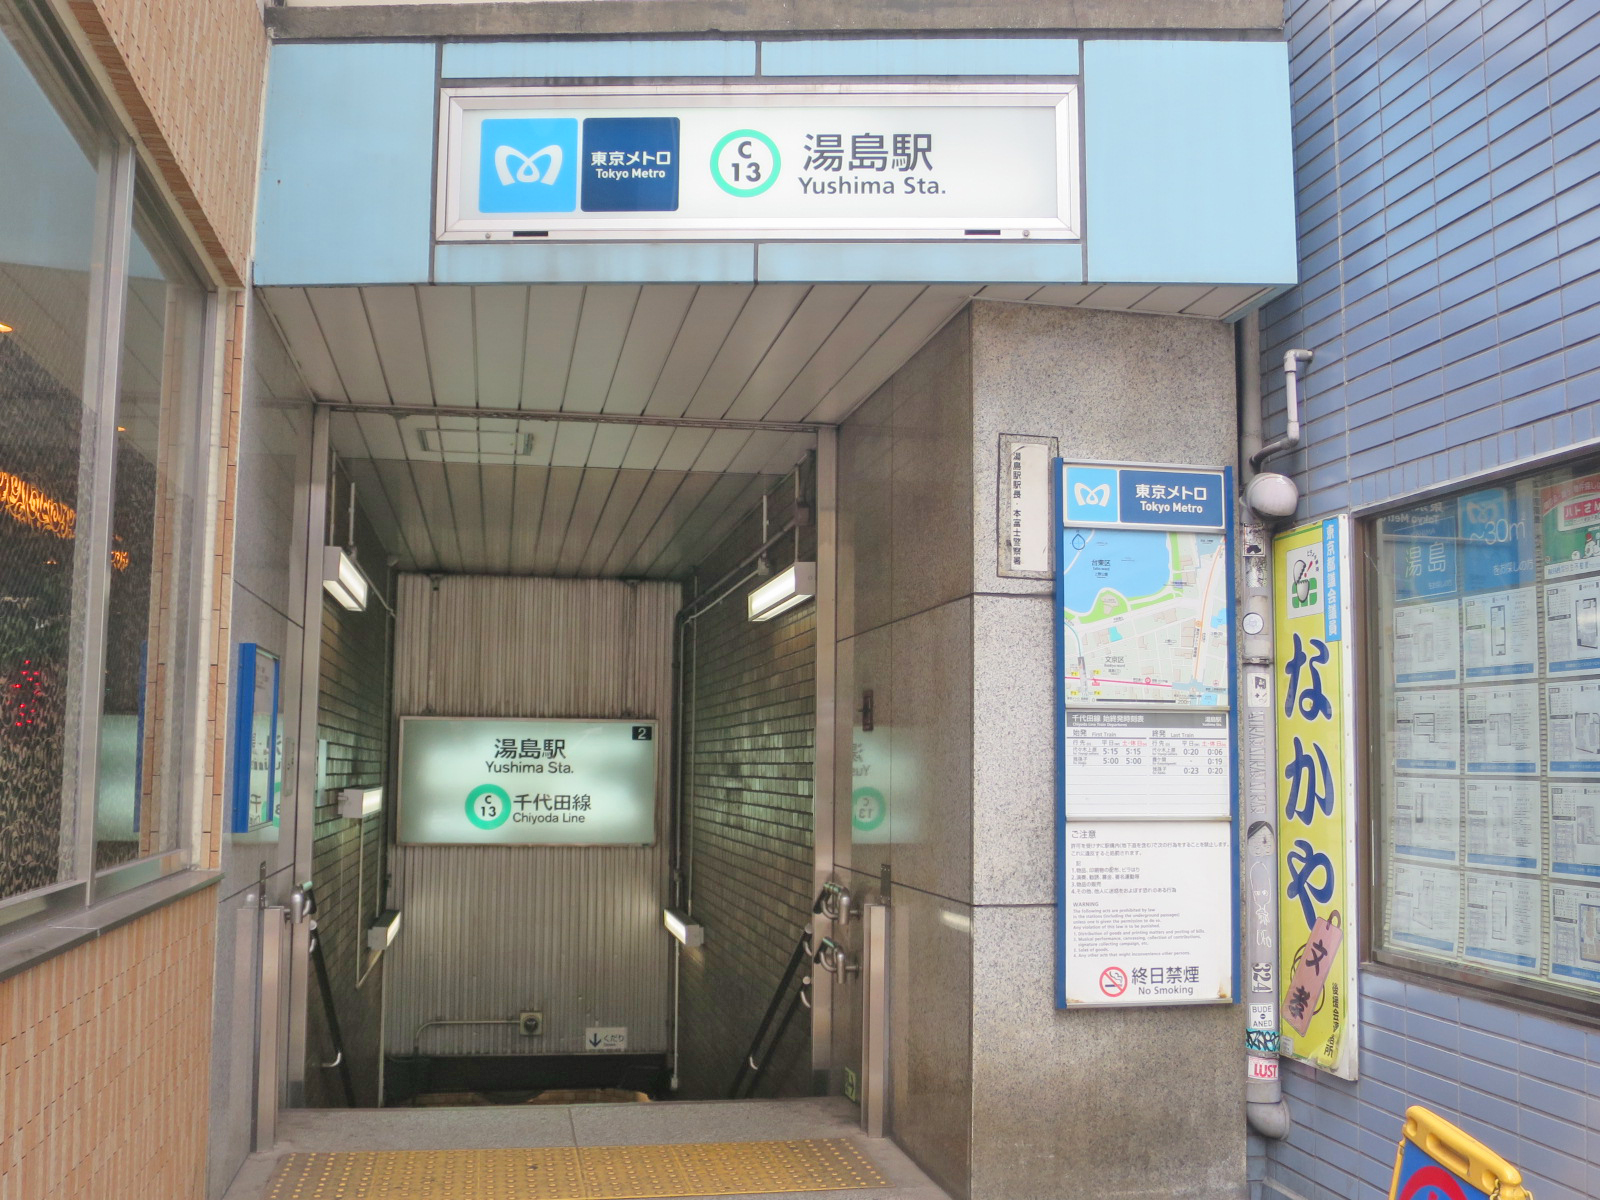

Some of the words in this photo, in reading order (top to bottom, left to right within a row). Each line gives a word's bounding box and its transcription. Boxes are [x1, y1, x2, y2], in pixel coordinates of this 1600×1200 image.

[736, 140, 753, 159] C
[803, 132, 933, 172] 湯島駅
[591, 150, 671, 167] 東京メトロ
[596, 168, 629, 181] Tokyo
[631, 168, 666, 179] Metro
[731, 161, 762, 183] 13
[798, 176, 895, 195] Yushima
[903, 176, 946, 195] Sta.
[1135, 483, 1207, 502] 東京メトロ
[1140, 500, 1170, 513] Tokyo
[1172, 502, 1203, 514] Metro
[1405, 541, 1446, 578] 湯島
[1072, 714, 1101, 722] 千代田線
[1102, 714, 1144, 723] 始終発時刻表
[637, 728, 646, 740] 2
[1072, 729, 1087, 737] 始発
[1151, 729, 1166, 738] 終発
[494, 738, 566, 760] 湯島駅
[1102, 747, 1118, 755] 5:15
[1125, 747, 1141, 755] 5:15
[1183, 748, 1199, 756] 0:20
[1207, 748, 1223, 756] 0:06
[1102, 757, 1119, 765] 5:00
[1125, 757, 1142, 765] 5:00
[1207, 757, 1223, 765] 0:19
[486, 761, 544, 774] Yushima
[548, 761, 574, 774] Sta.
[1183, 767, 1199, 775] 0:23
[1207, 767, 1223, 775] 0:20
[1285, 632, 1335, 932] なかや
[484, 795, 492, 805] C
[513, 793, 591, 812] 千代田線
[481, 806, 497, 818] 13
[512, 812, 559, 825] Chiyoda
[562, 813, 586, 824] Line
[1071, 830, 1097, 840] ご注意
[1131, 966, 1200, 985] 終日禁煙
[1252, 963, 1273, 992] 324
[1138, 986, 1151, 996] No
[1154, 986, 1194, 997] Smoking
[1252, 1005, 1273, 1014] BUDE
[1252, 1019, 1273, 1028] ANED
[1254, 1063, 1278, 1079] LUST
